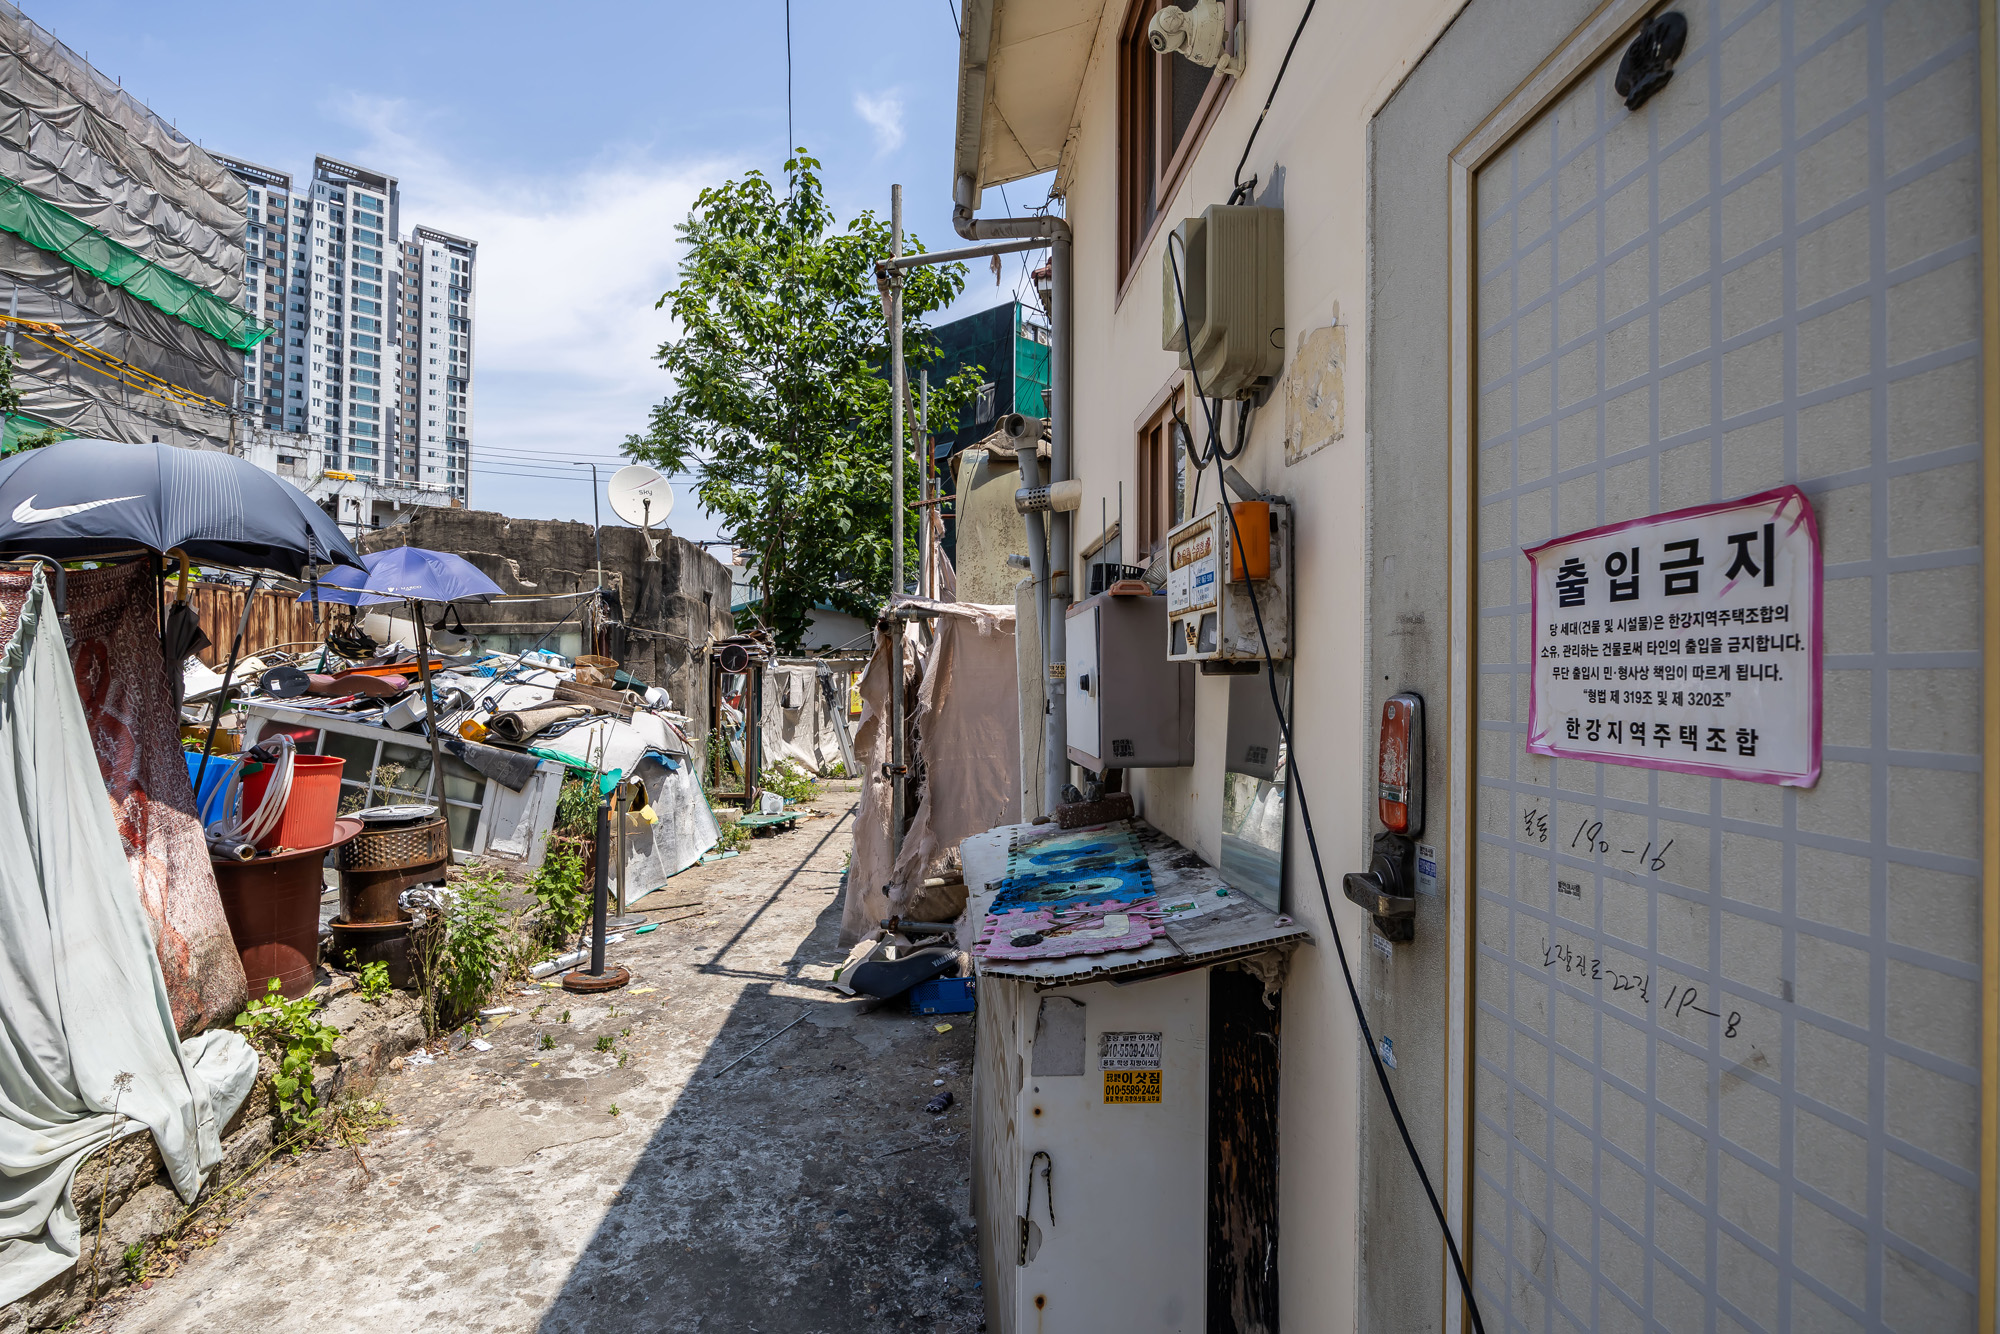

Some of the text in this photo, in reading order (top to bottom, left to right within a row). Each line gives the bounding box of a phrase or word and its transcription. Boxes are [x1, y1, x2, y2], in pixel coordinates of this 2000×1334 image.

[1556, 522, 1775, 608] 출입금지
[1550, 604, 1789, 636] 당 세대(건물 및 시설물)은 한강지역주택조합의
[1540, 633, 1805, 658] 소유, 관리하는 건물로써 타인의 출입을 금지합니다.
[1552, 664, 1783, 682] 무단 출입시 민·형사상 책임이 따르게 됩니다.
[1610, 690, 1620, 704] 제
[1623, 690, 1652, 704] 319조
[1657, 690, 1668, 706] 및
[1672, 692, 1683, 706] 제
[1566, 716, 1758, 756] 한강지역주택조합
[1122, 1072, 1160, 1084] 이삿짐
